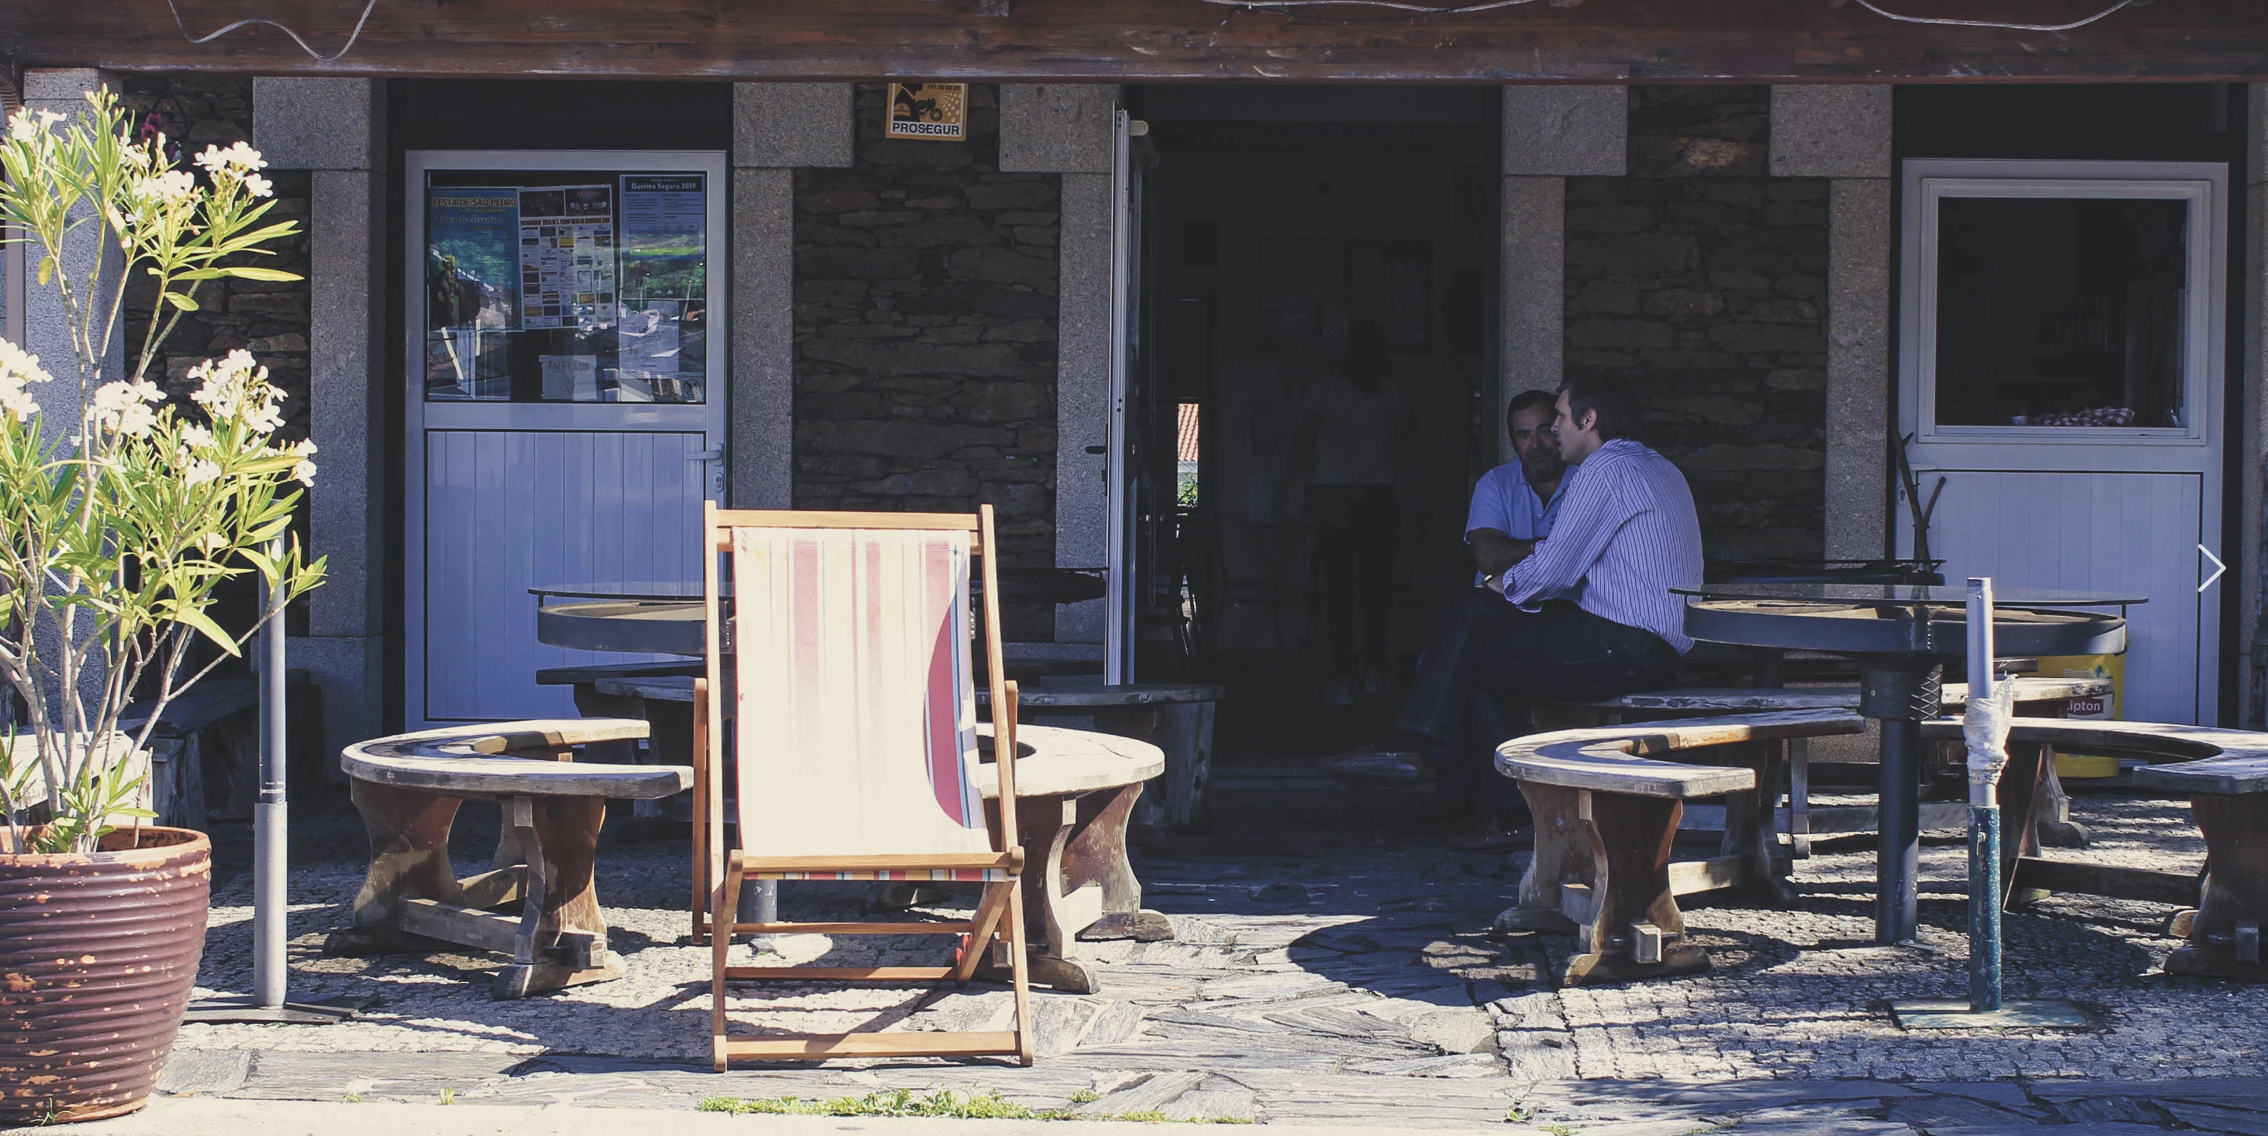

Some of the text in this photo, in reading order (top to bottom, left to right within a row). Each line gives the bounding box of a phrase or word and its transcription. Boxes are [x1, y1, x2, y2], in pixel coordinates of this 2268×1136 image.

[892, 122, 960, 135] PROSEGUR
[631, 182, 697, 191] Queima Segura 2019
[433, 196, 517, 207] FESTA DE SÃO PEDRO
[2067, 700, 2101, 713] ipton
